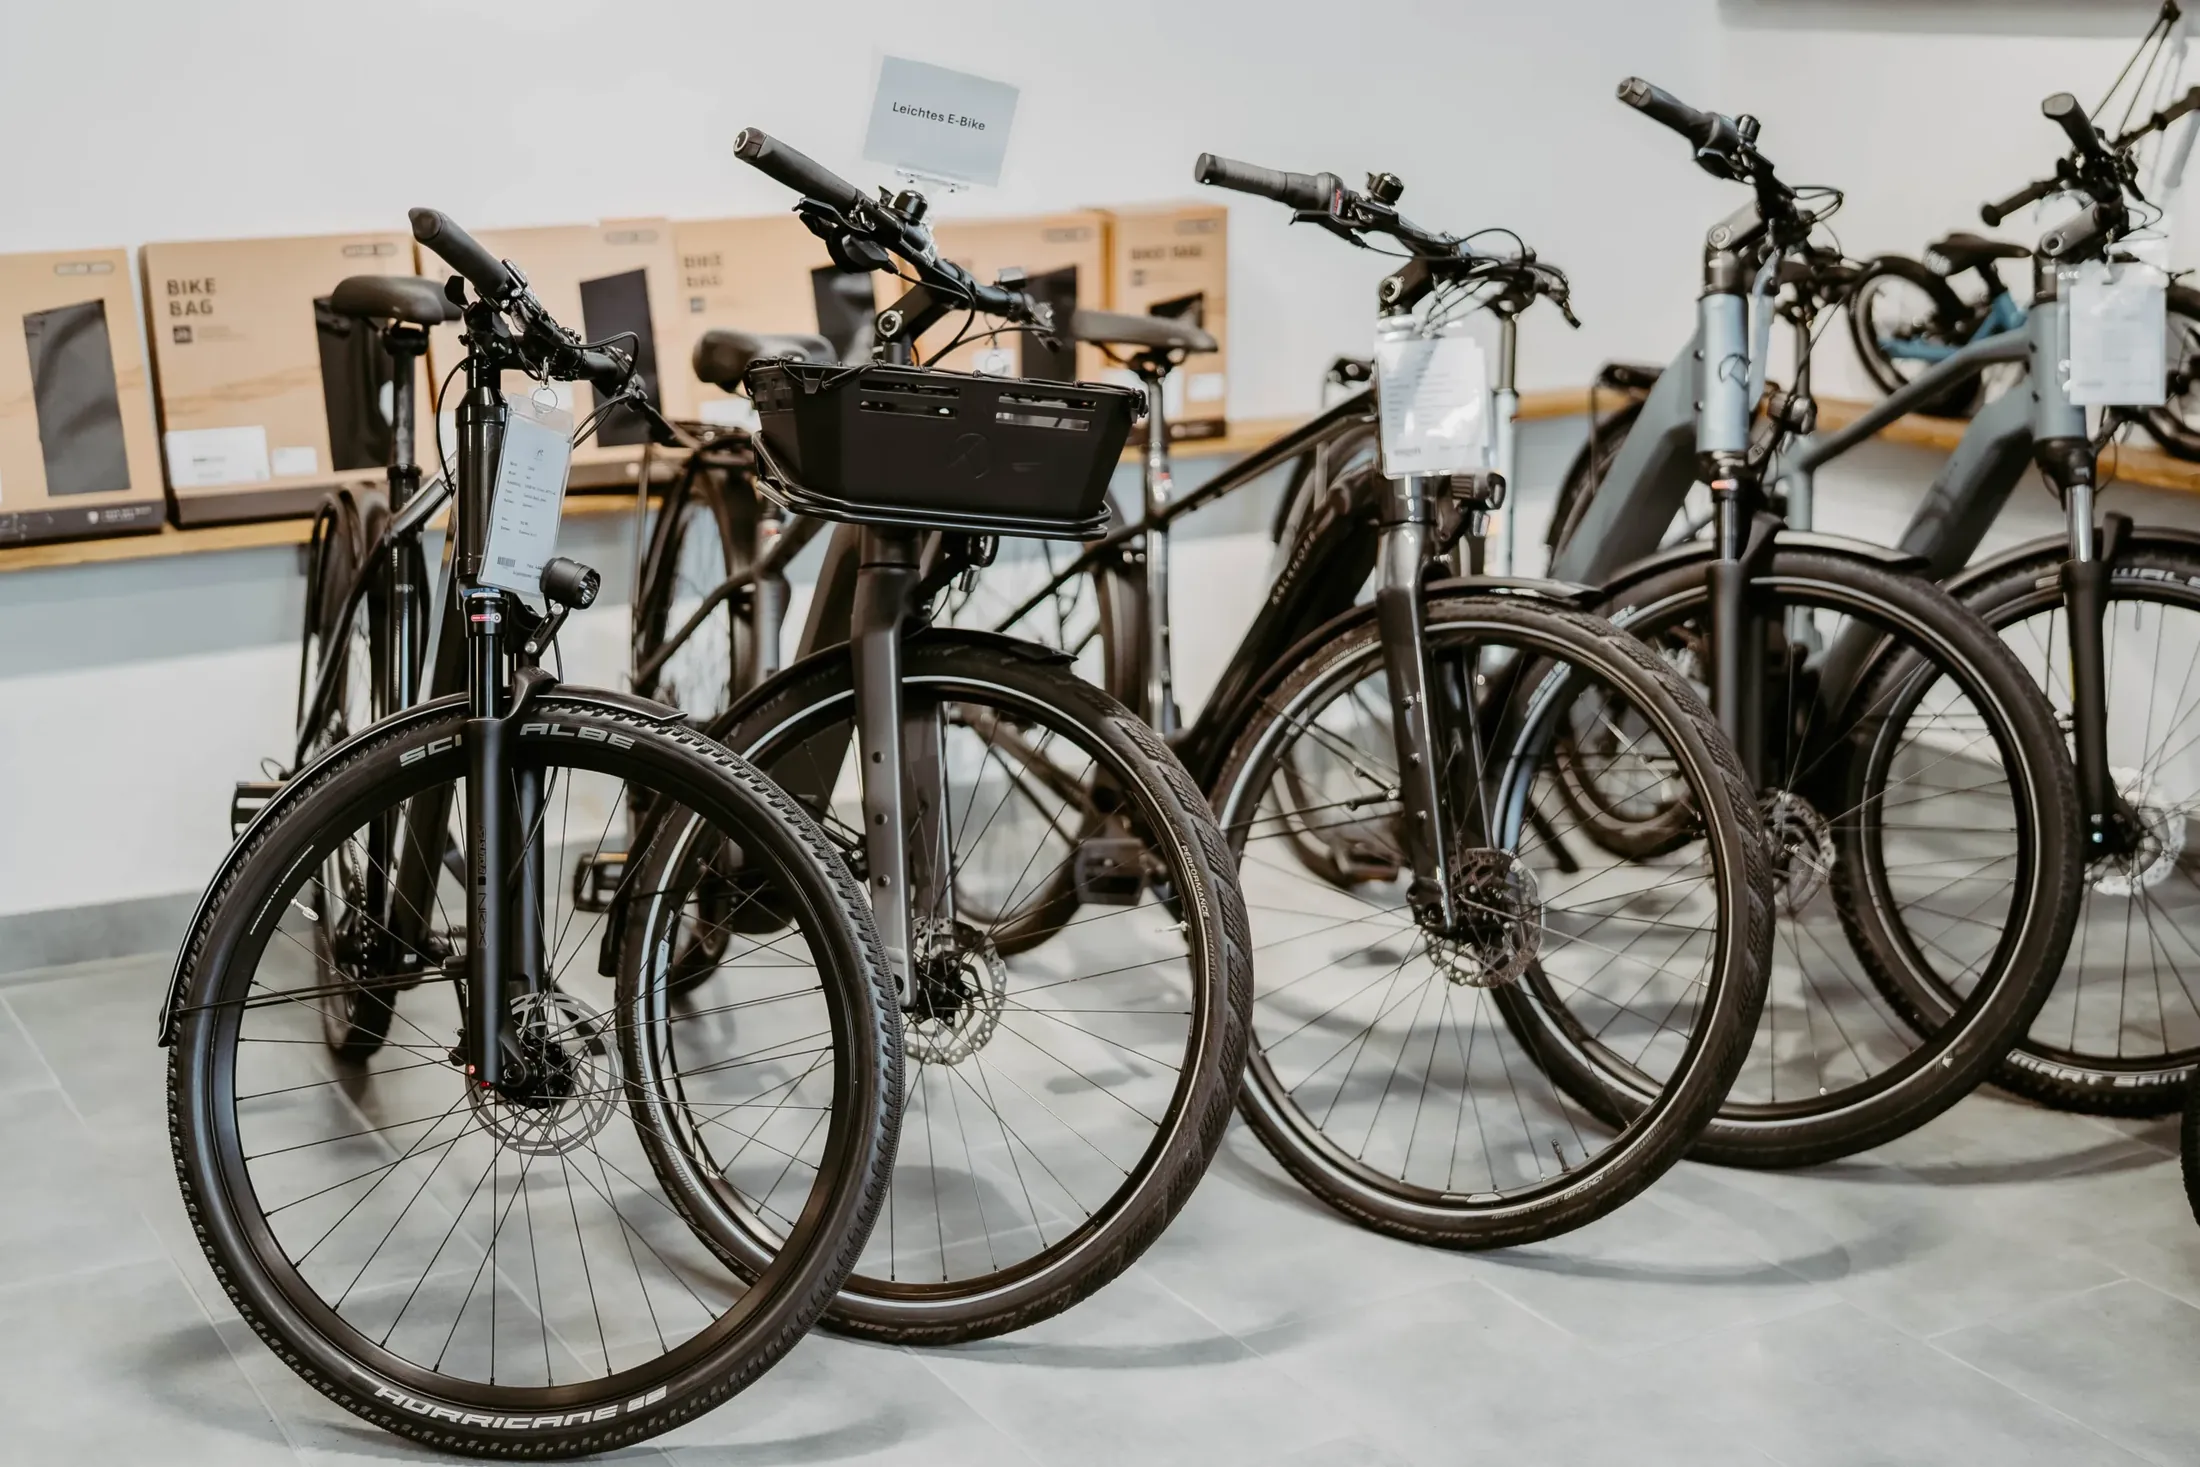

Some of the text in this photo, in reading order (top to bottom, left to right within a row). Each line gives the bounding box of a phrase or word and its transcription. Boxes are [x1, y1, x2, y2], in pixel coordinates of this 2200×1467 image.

[892, 101, 986, 131] Leichtes E-Bike
[166, 277, 216, 296] BIKE
[169, 298, 213, 317] BAG
[1181, 845, 1210, 918] PERFORMANCE
[374, 1386, 618, 1430] HURRICANE
